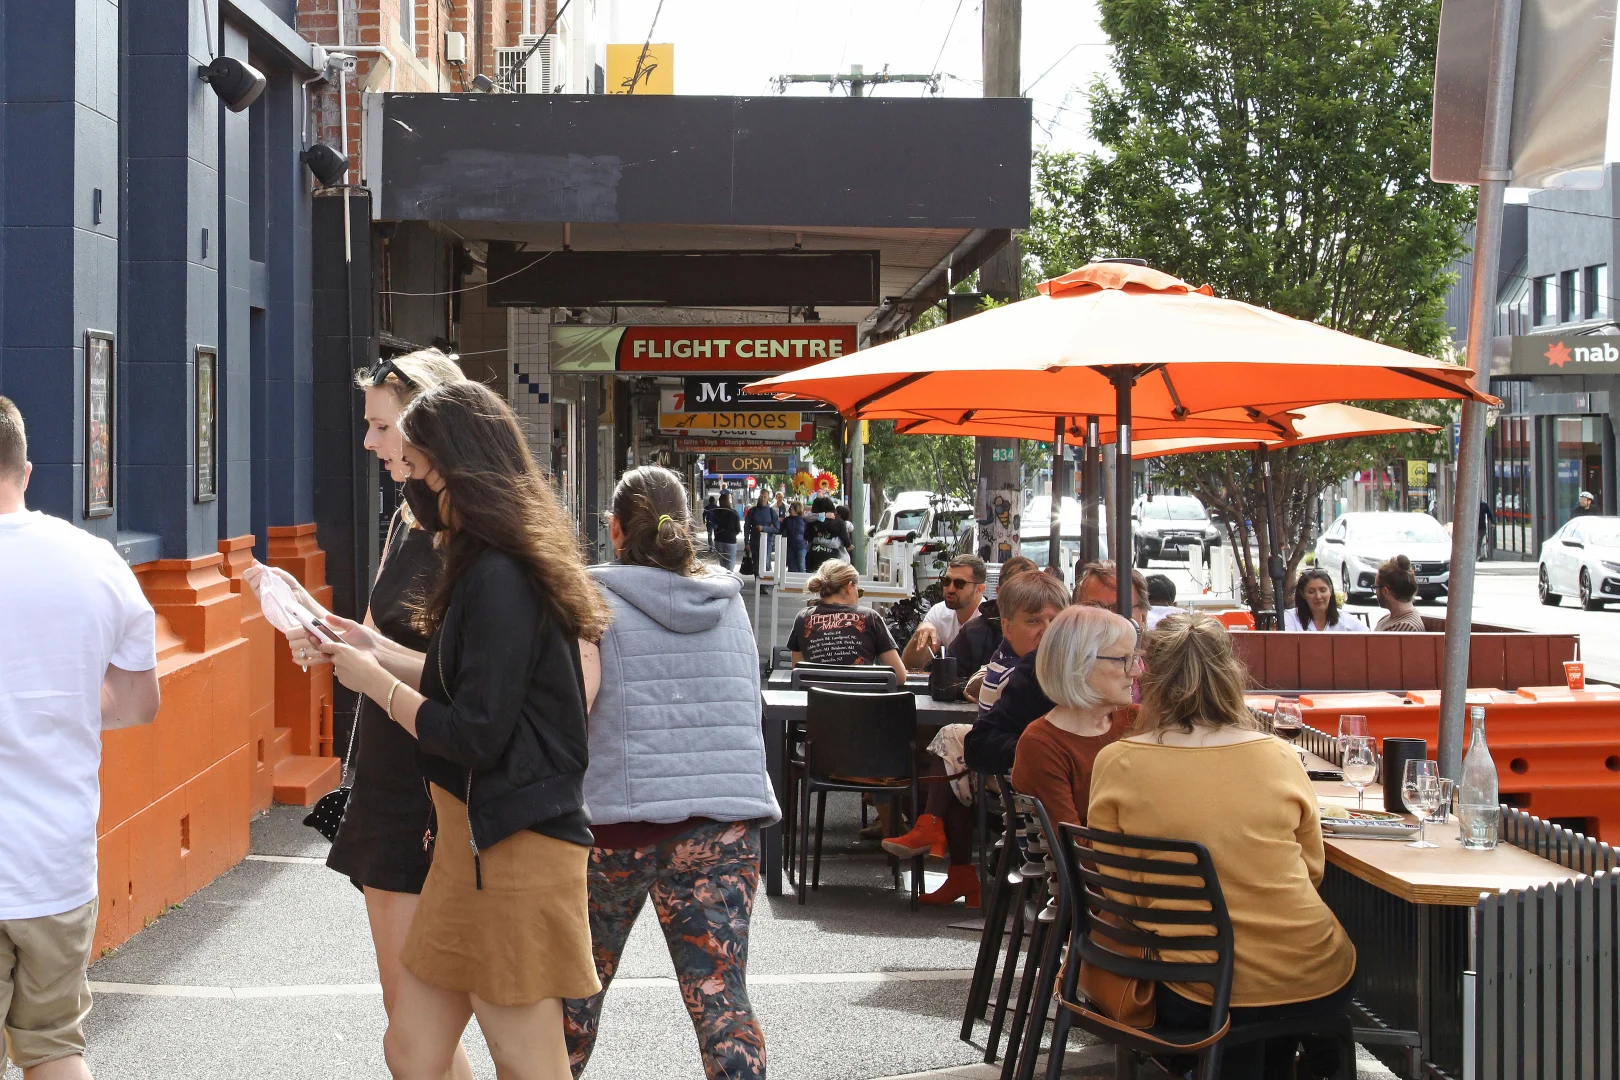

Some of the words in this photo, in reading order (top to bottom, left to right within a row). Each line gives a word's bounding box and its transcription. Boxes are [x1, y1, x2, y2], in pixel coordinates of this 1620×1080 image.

[633, 339, 731, 359] FLIGHT
[735, 339, 843, 358] CENTRE
[1574, 342, 1619, 363] nab
[724, 439, 745, 447] Change
[993, 448, 1014, 461] 434
[732, 457, 773, 470] OPSM
[808, 612, 860, 628] FLEETWOOD
